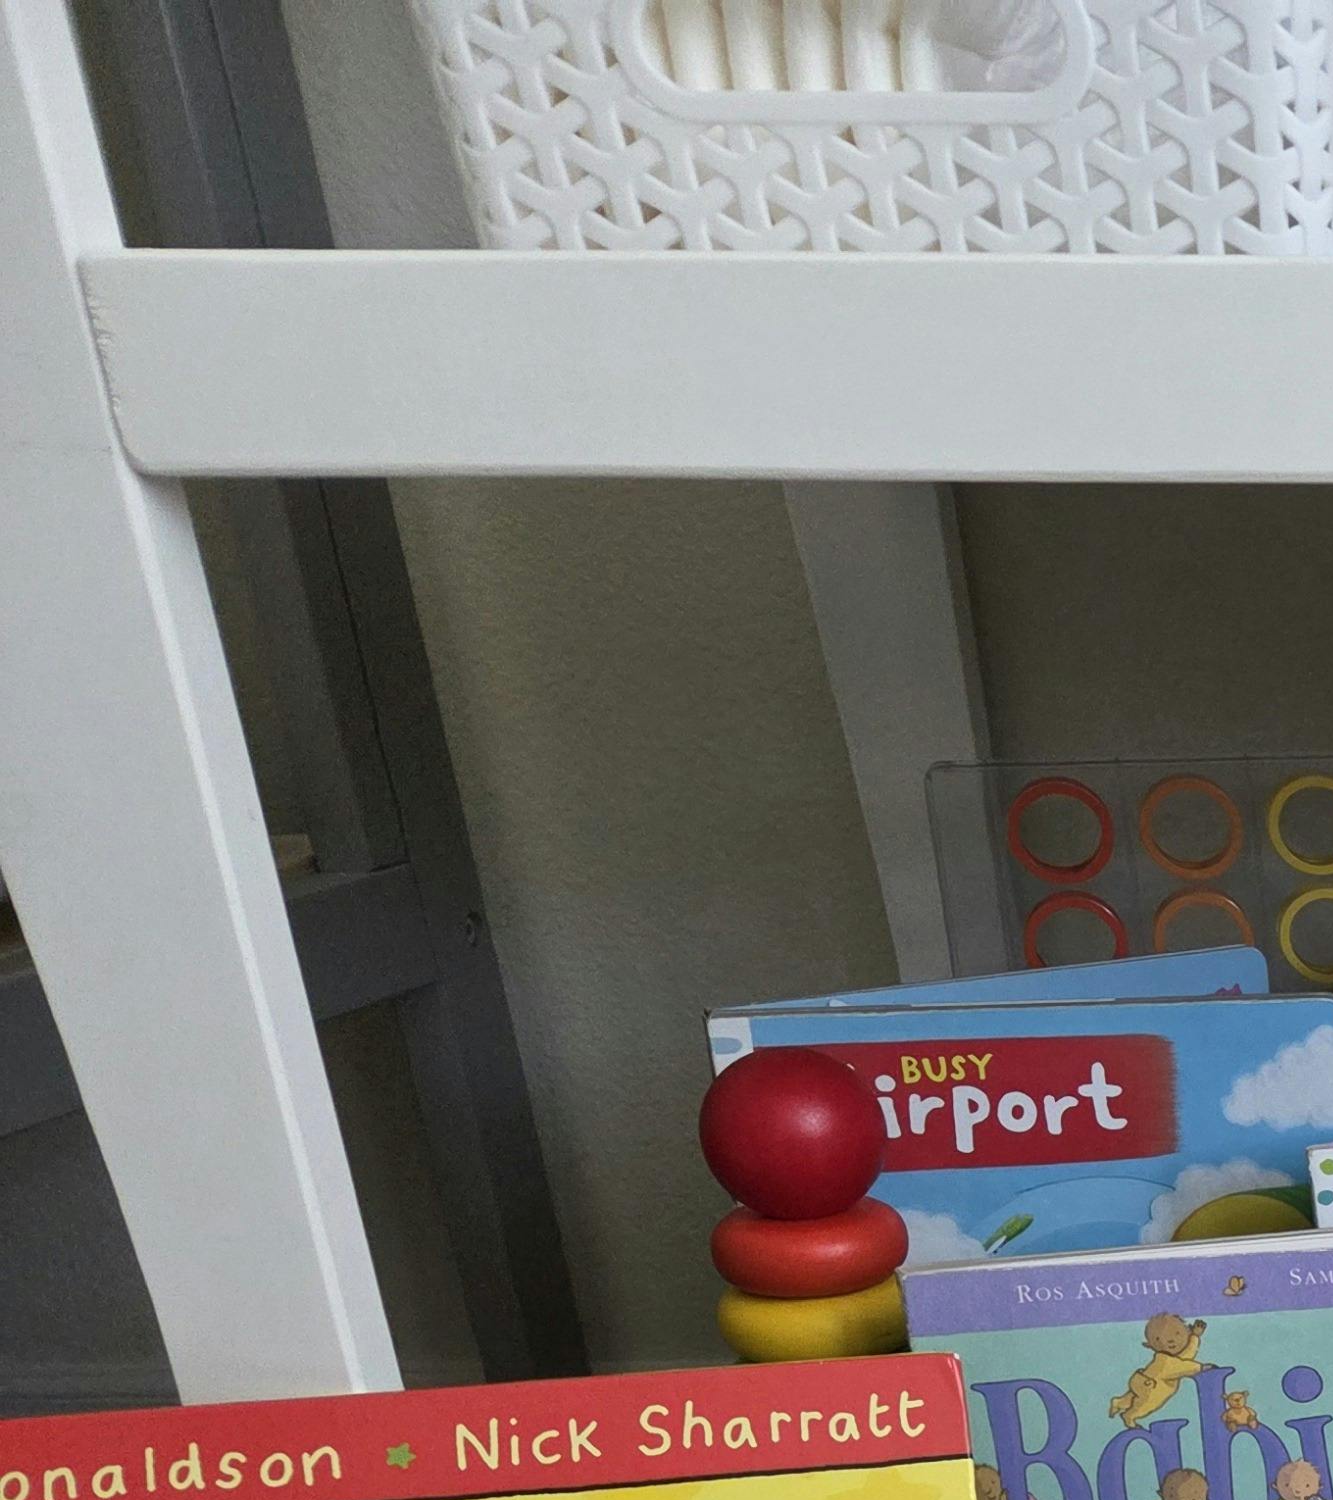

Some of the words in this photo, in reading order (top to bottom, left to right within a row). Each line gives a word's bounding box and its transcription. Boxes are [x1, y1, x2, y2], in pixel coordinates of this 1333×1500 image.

[874, 1062, 1130, 1154] irport
[900, 1053, 994, 1085] BUSY
[455, 1418, 602, 1471] Nick
[638, 1391, 927, 1457] Sharratt
